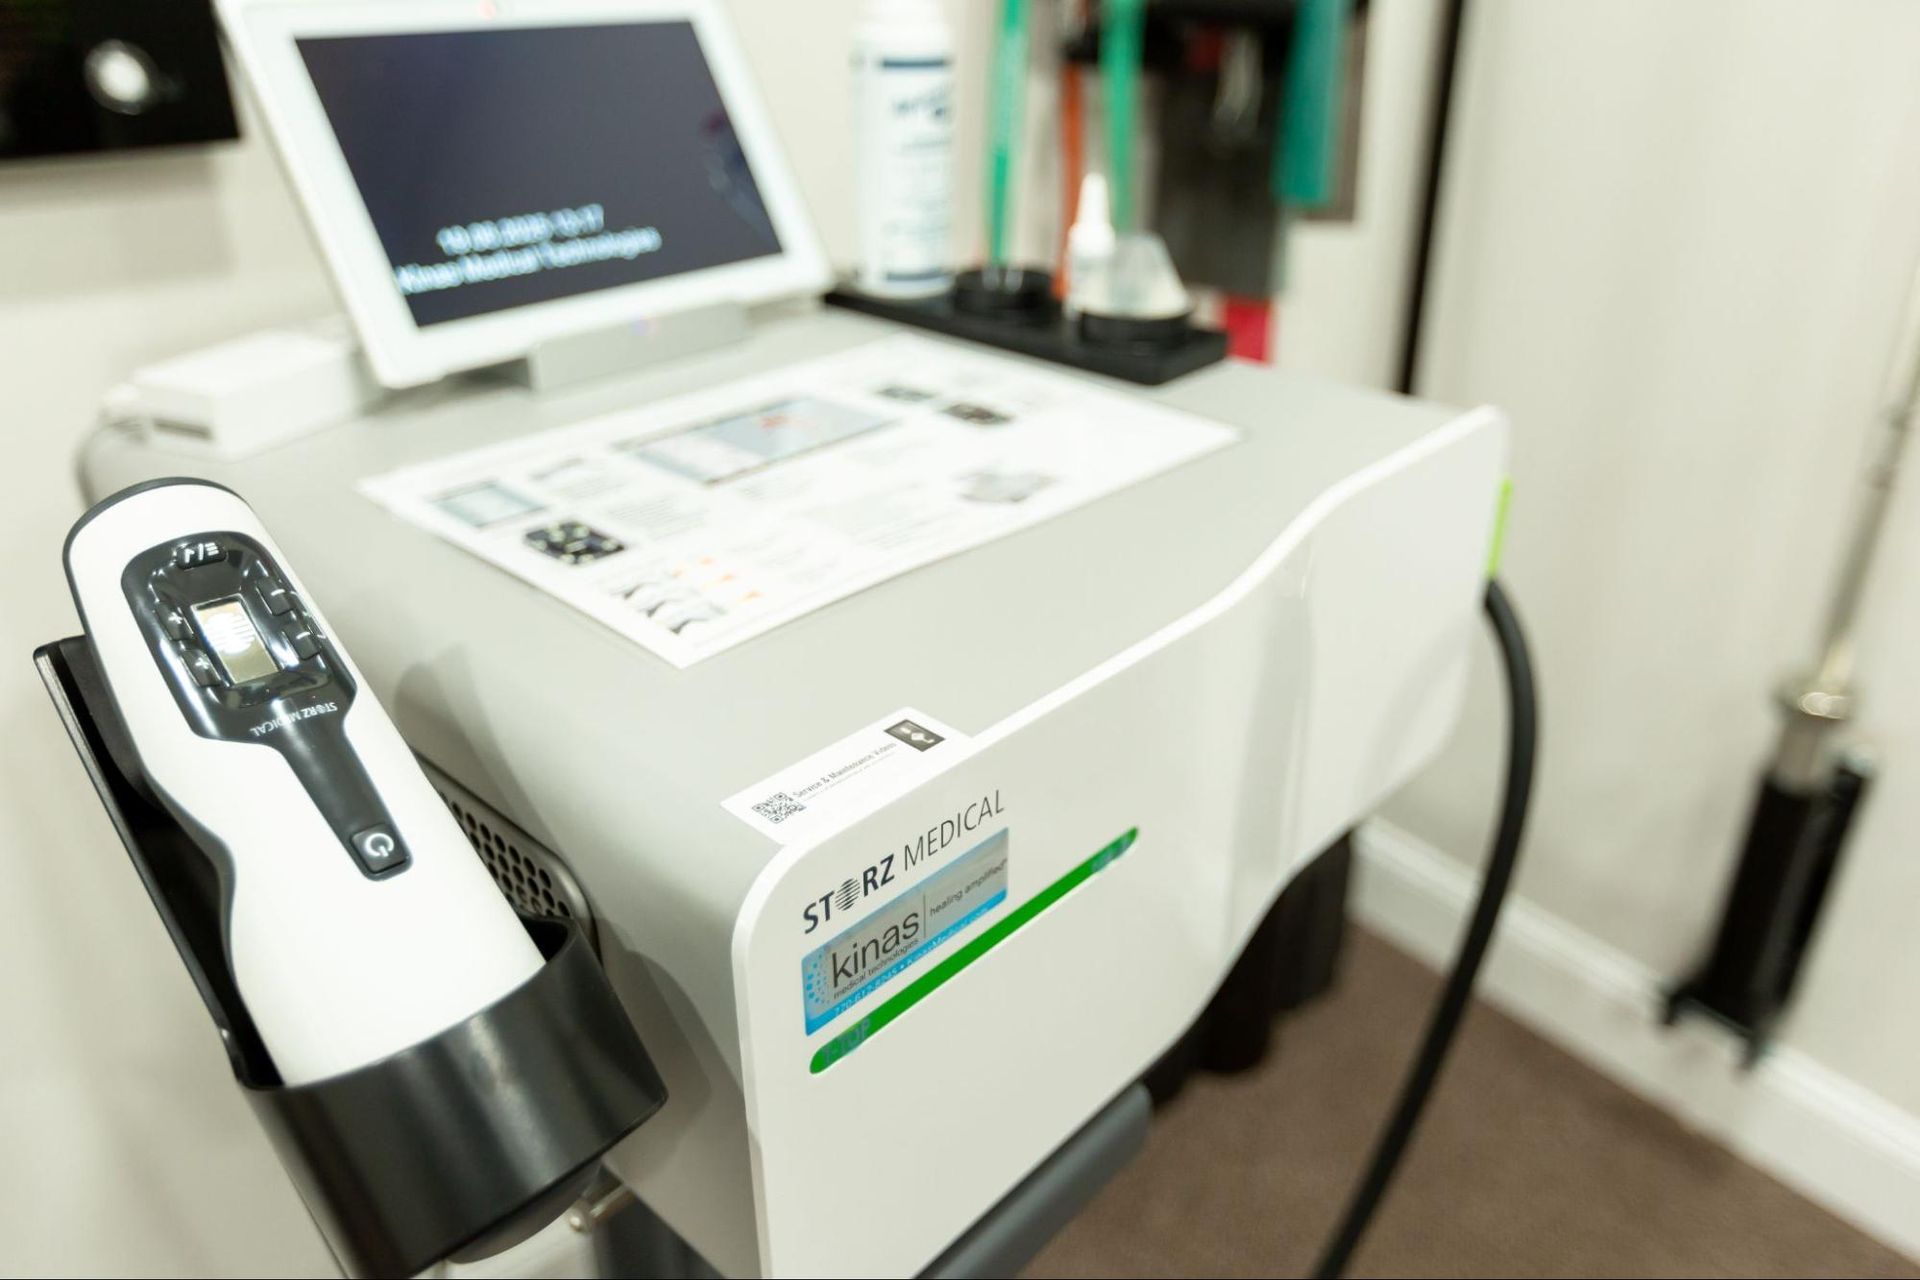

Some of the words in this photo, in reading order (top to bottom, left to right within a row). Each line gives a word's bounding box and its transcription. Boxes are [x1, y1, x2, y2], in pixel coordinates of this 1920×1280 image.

[249, 711, 301, 736] MDICAL
[300, 702, 338, 718] STORZ
[802, 854, 895, 934] STORZ
[904, 790, 1004, 871] MEDICAL
[930, 890, 963, 916] healing
[832, 912, 919, 988] kinas
[834, 972, 866, 999] medical
[868, 938, 920, 975] technologies
